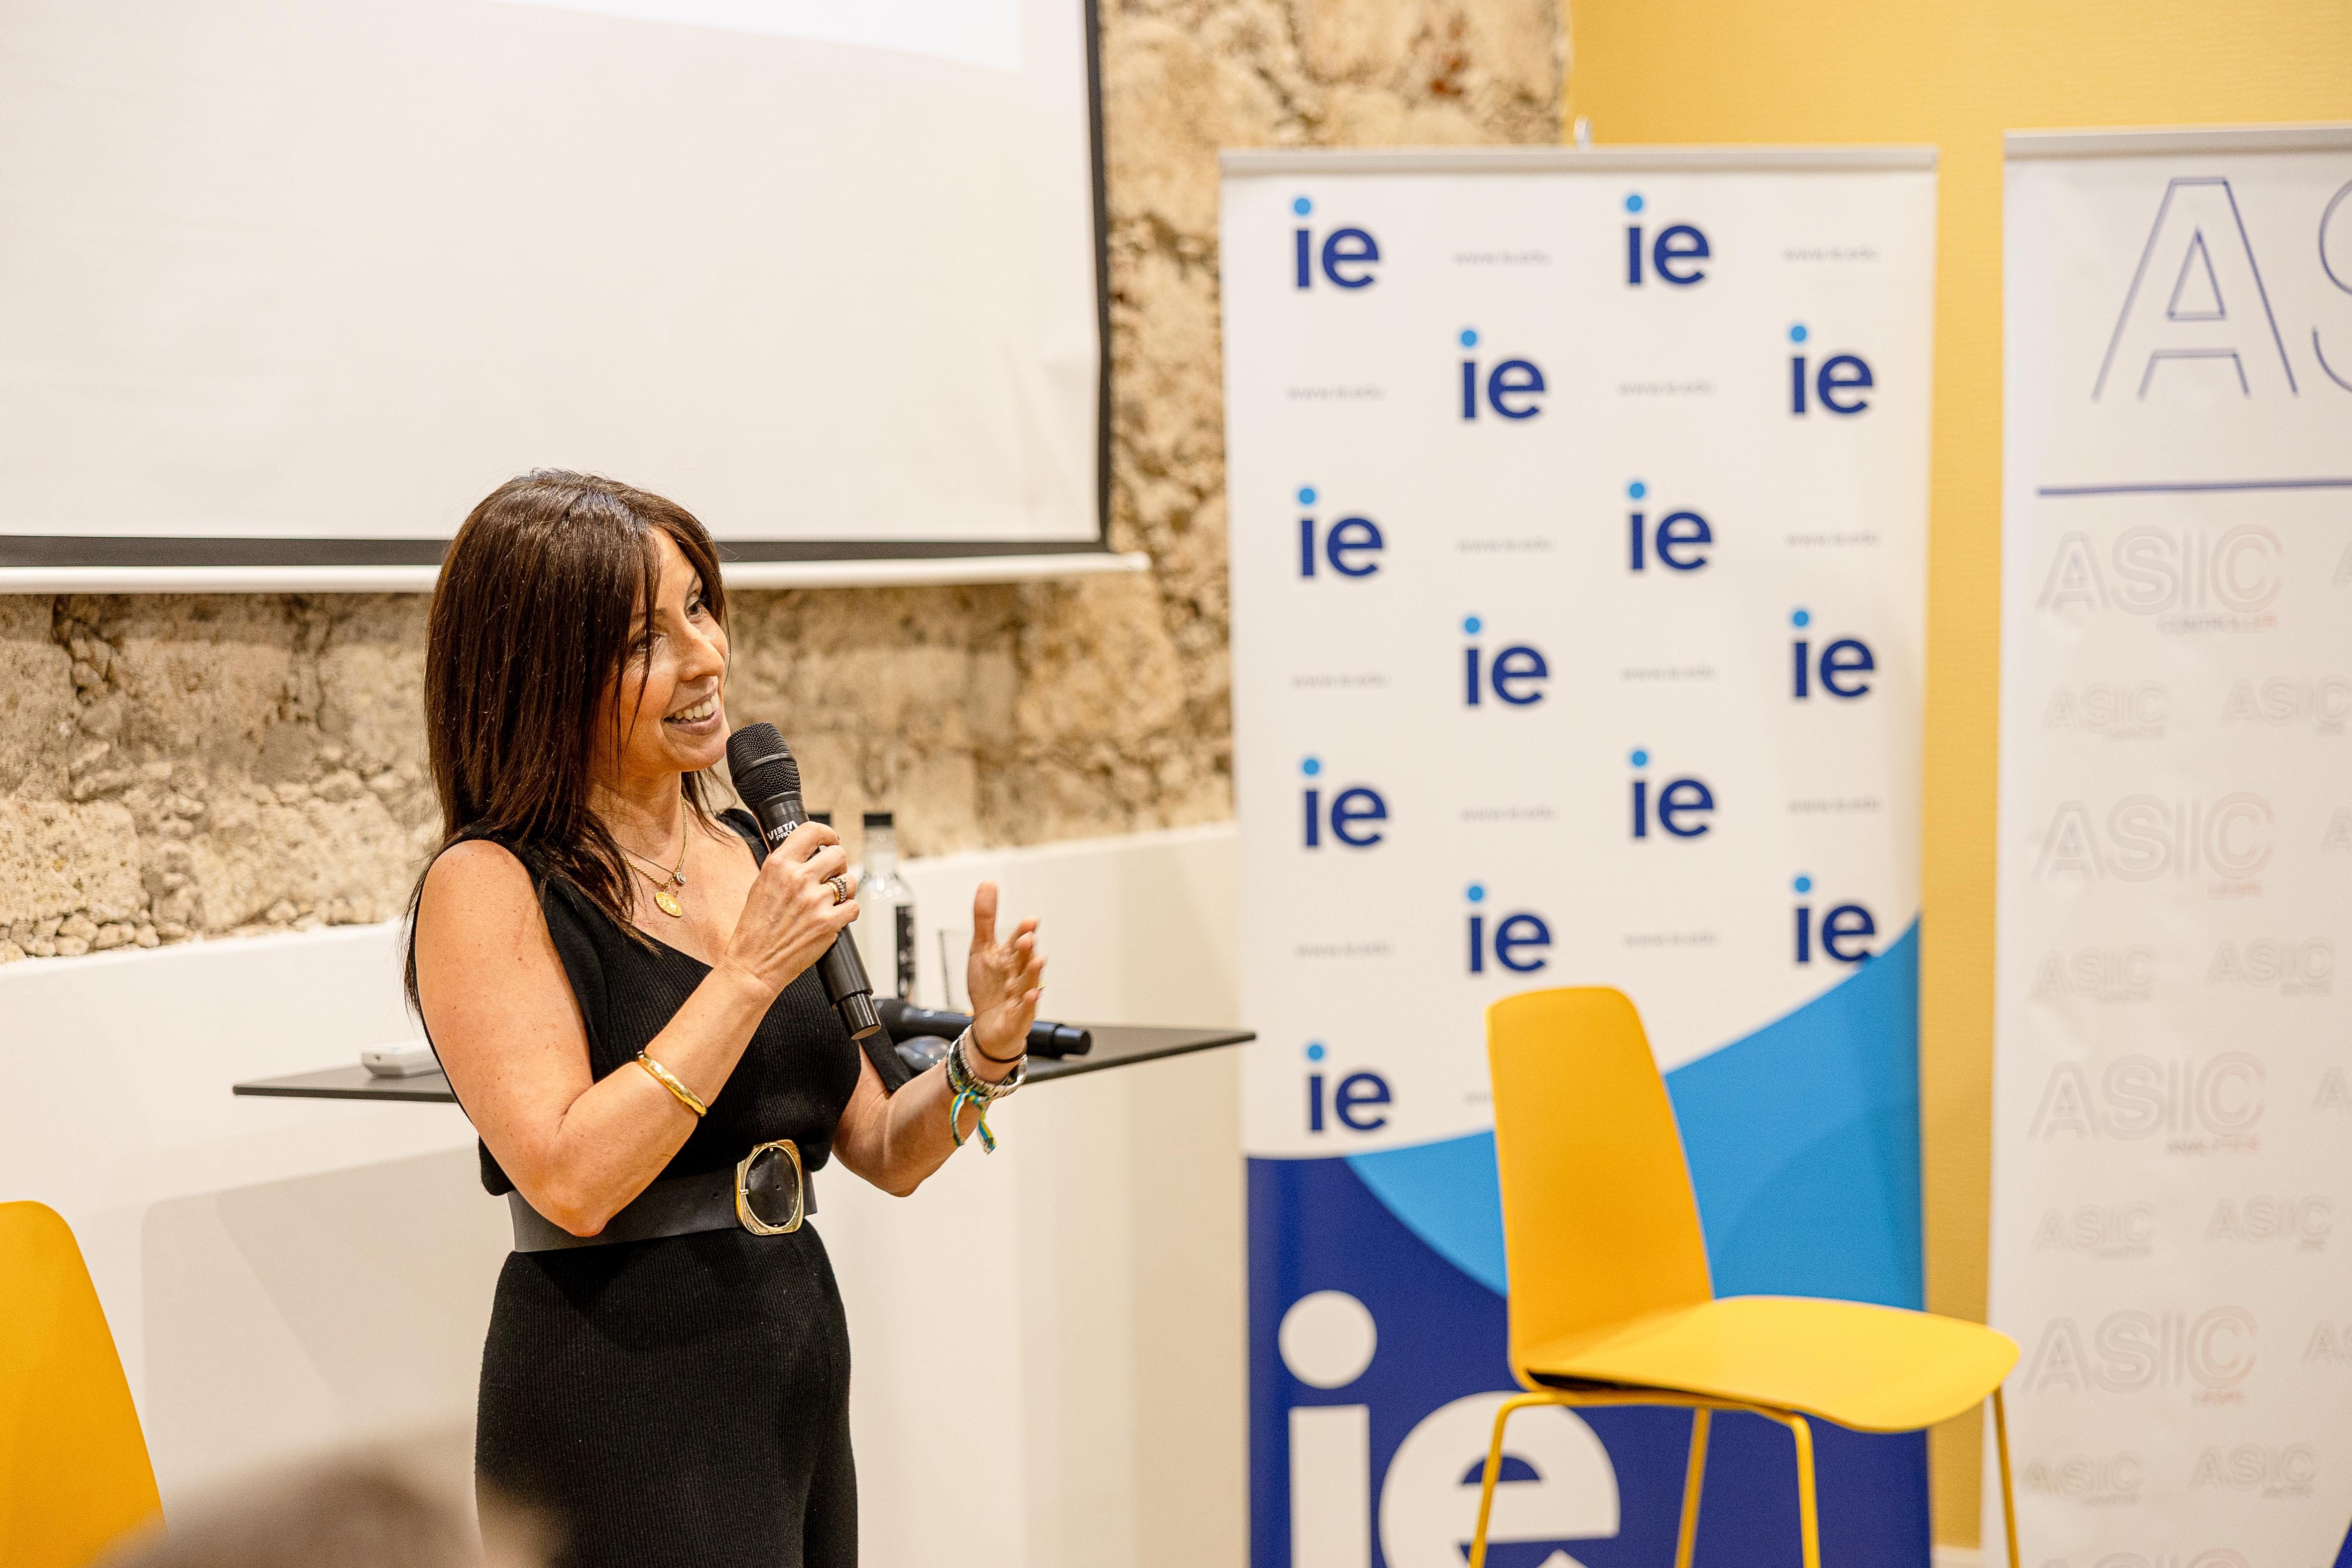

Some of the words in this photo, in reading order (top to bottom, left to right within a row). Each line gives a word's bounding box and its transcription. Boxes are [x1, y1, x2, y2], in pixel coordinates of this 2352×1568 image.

[1294, 196, 1381, 290] ie
[1625, 193, 1711, 286] ie
[2092, 177, 2352, 400] A
[1459, 328, 1546, 421] ie
[1789, 324, 1874, 416] ie
[1297, 486, 1385, 578] ie
[1628, 481, 1713, 572] ie
[2035, 523, 2284, 615] ASIC
[1463, 615, 1549, 707] ie
[1791, 608, 1876, 700] ie
[767, 820, 799, 841] VIETA
[776, 830, 792, 841] PRO
[1301, 757, 1389, 848] ie
[1630, 749, 1716, 839] ie
[2031, 791, 2275, 882] ASIC
[1466, 883, 1552, 974] ie
[1793, 874, 1877, 964] ie
[1306, 1042, 1393, 1133] ie
[2026, 1051, 2267, 1141] ASIC
[2020, 1305, 2258, 1393] ASIC
[1279, 1290, 1620, 1568] ie
